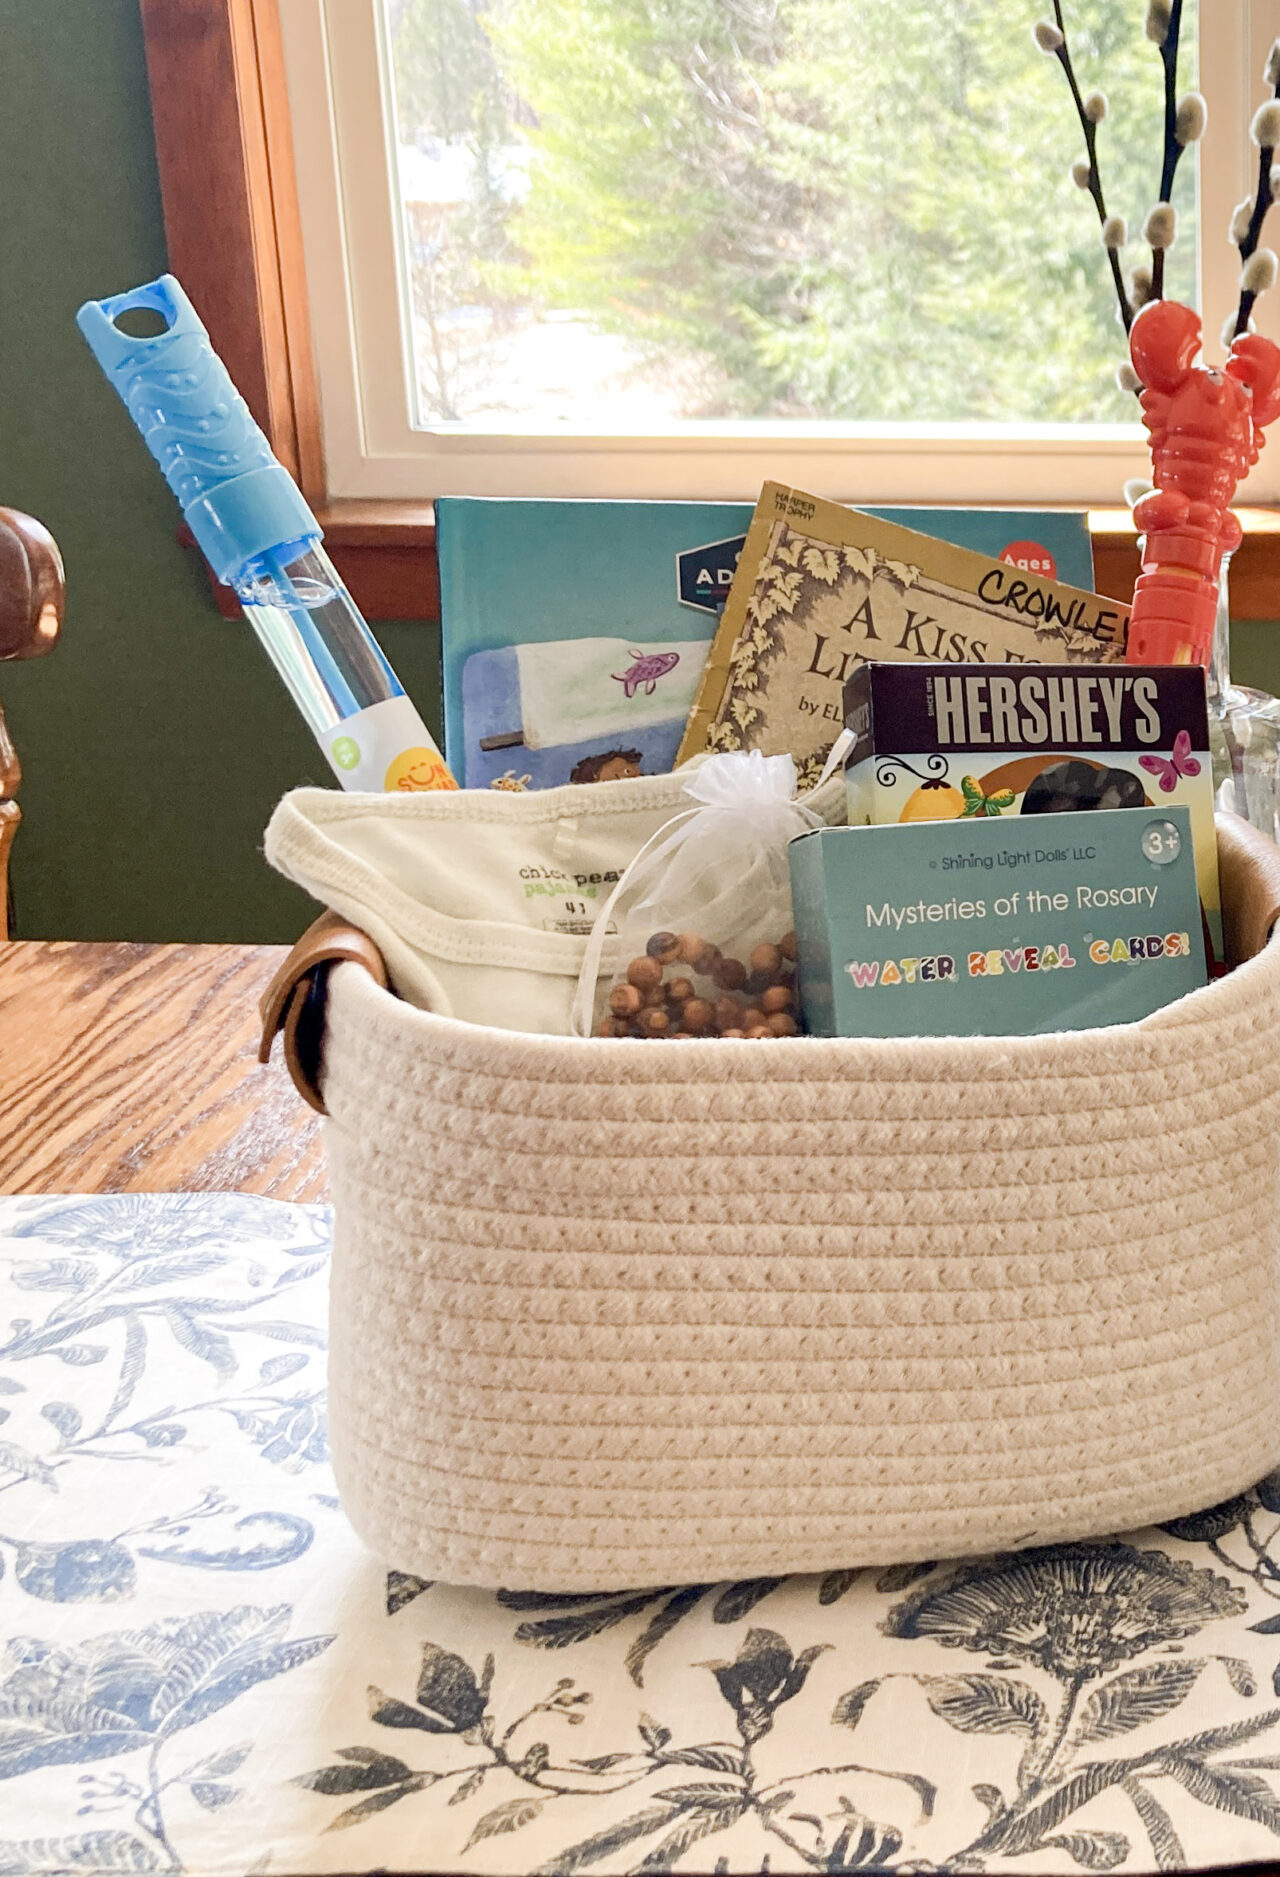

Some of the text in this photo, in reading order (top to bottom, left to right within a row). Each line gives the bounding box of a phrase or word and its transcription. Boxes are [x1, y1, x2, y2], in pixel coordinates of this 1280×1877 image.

[841, 596, 987, 663] A KISS
[798, 696, 820, 716] by
[934, 676, 1161, 744] HERSHEY'S
[942, 854, 993, 870] Shining
[998, 851, 1031, 868] Light
[1073, 847, 1096, 860] LLC
[1149, 832, 1178, 854] 3+
[866, 885, 1158, 930] Mysteries of the Rosary
[850, 932, 1190, 988] WATER REVEAL CARDS!
